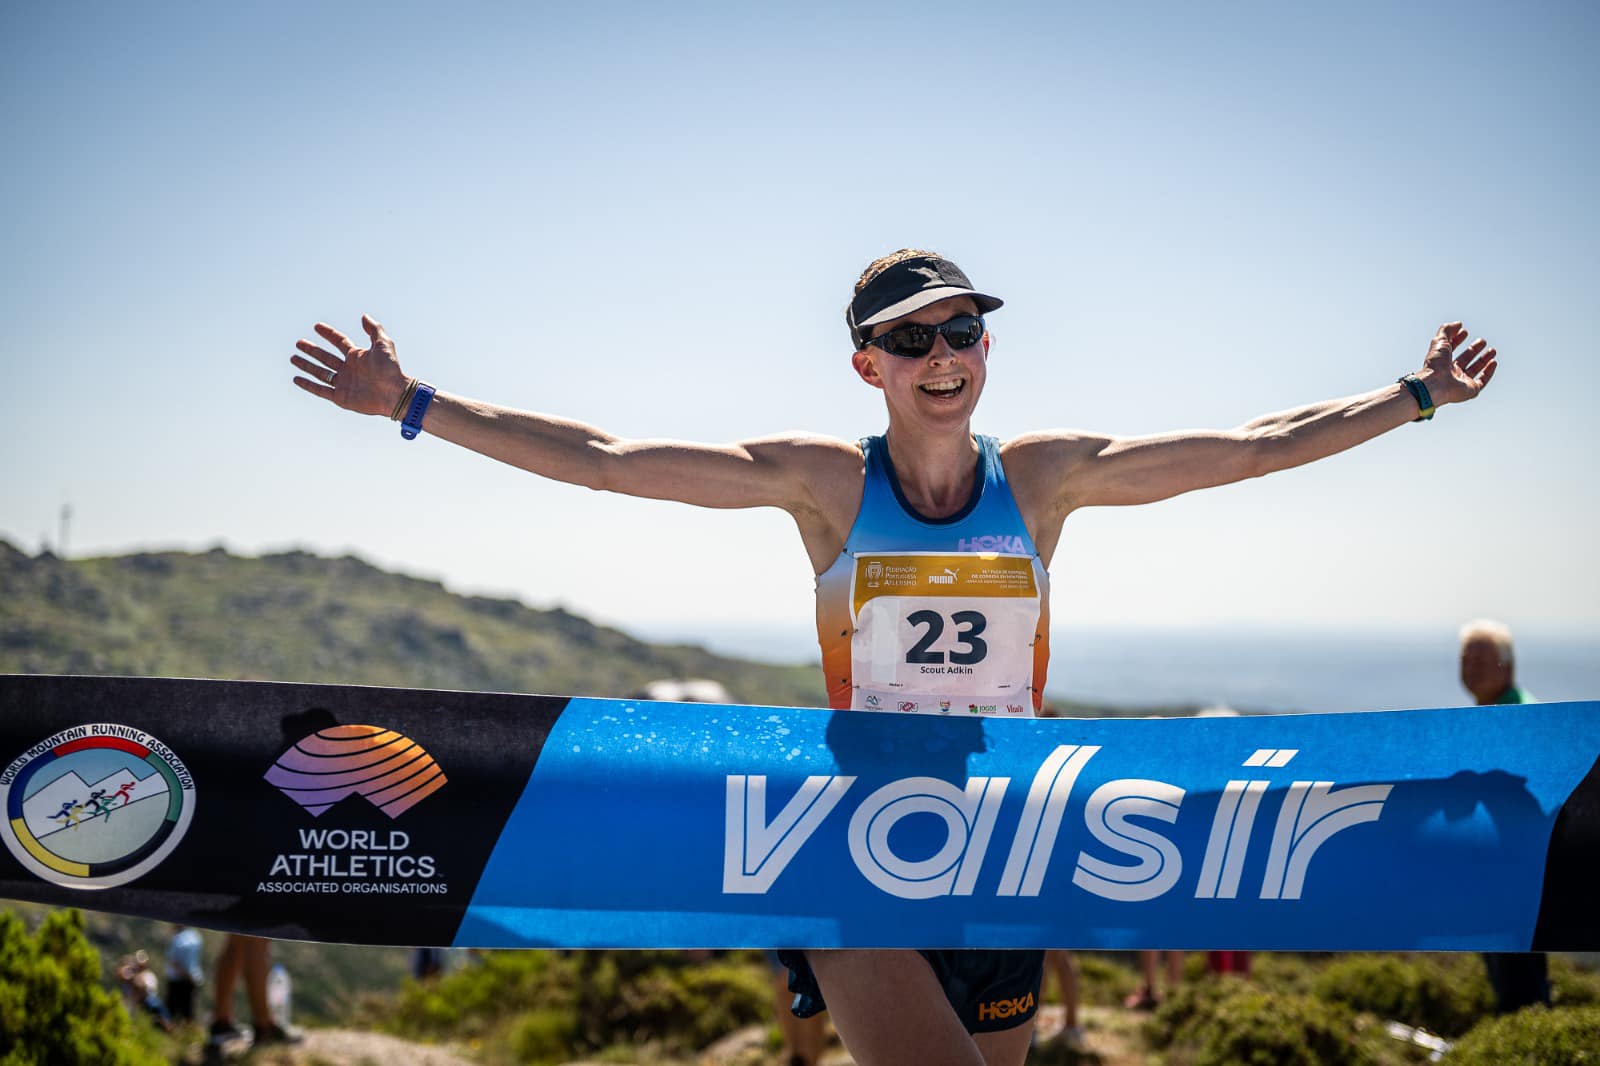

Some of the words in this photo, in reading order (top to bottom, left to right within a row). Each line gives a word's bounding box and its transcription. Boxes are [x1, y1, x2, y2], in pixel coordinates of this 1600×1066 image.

[958, 535, 1026, 554] HOKA
[928, 575, 953, 584] PUMA
[905, 609, 988, 665] 23
[920, 665, 945, 675] Scout
[947, 665, 973, 675] Adkin
[1, 756, 28, 785] WORLD
[30, 726, 88, 758] MOUNTAIN
[92, 724, 146, 743] RUNNING
[146, 739, 194, 790] ASSOCIATION
[722, 744, 1394, 903] valsir
[299, 828, 410, 850] WORLD
[269, 854, 436, 878] ATHLETICS
[256, 882, 339, 893] ASSOCIATED
[342, 883, 448, 895] ORGANISATIONS
[978, 991, 1034, 1022] HOKA
